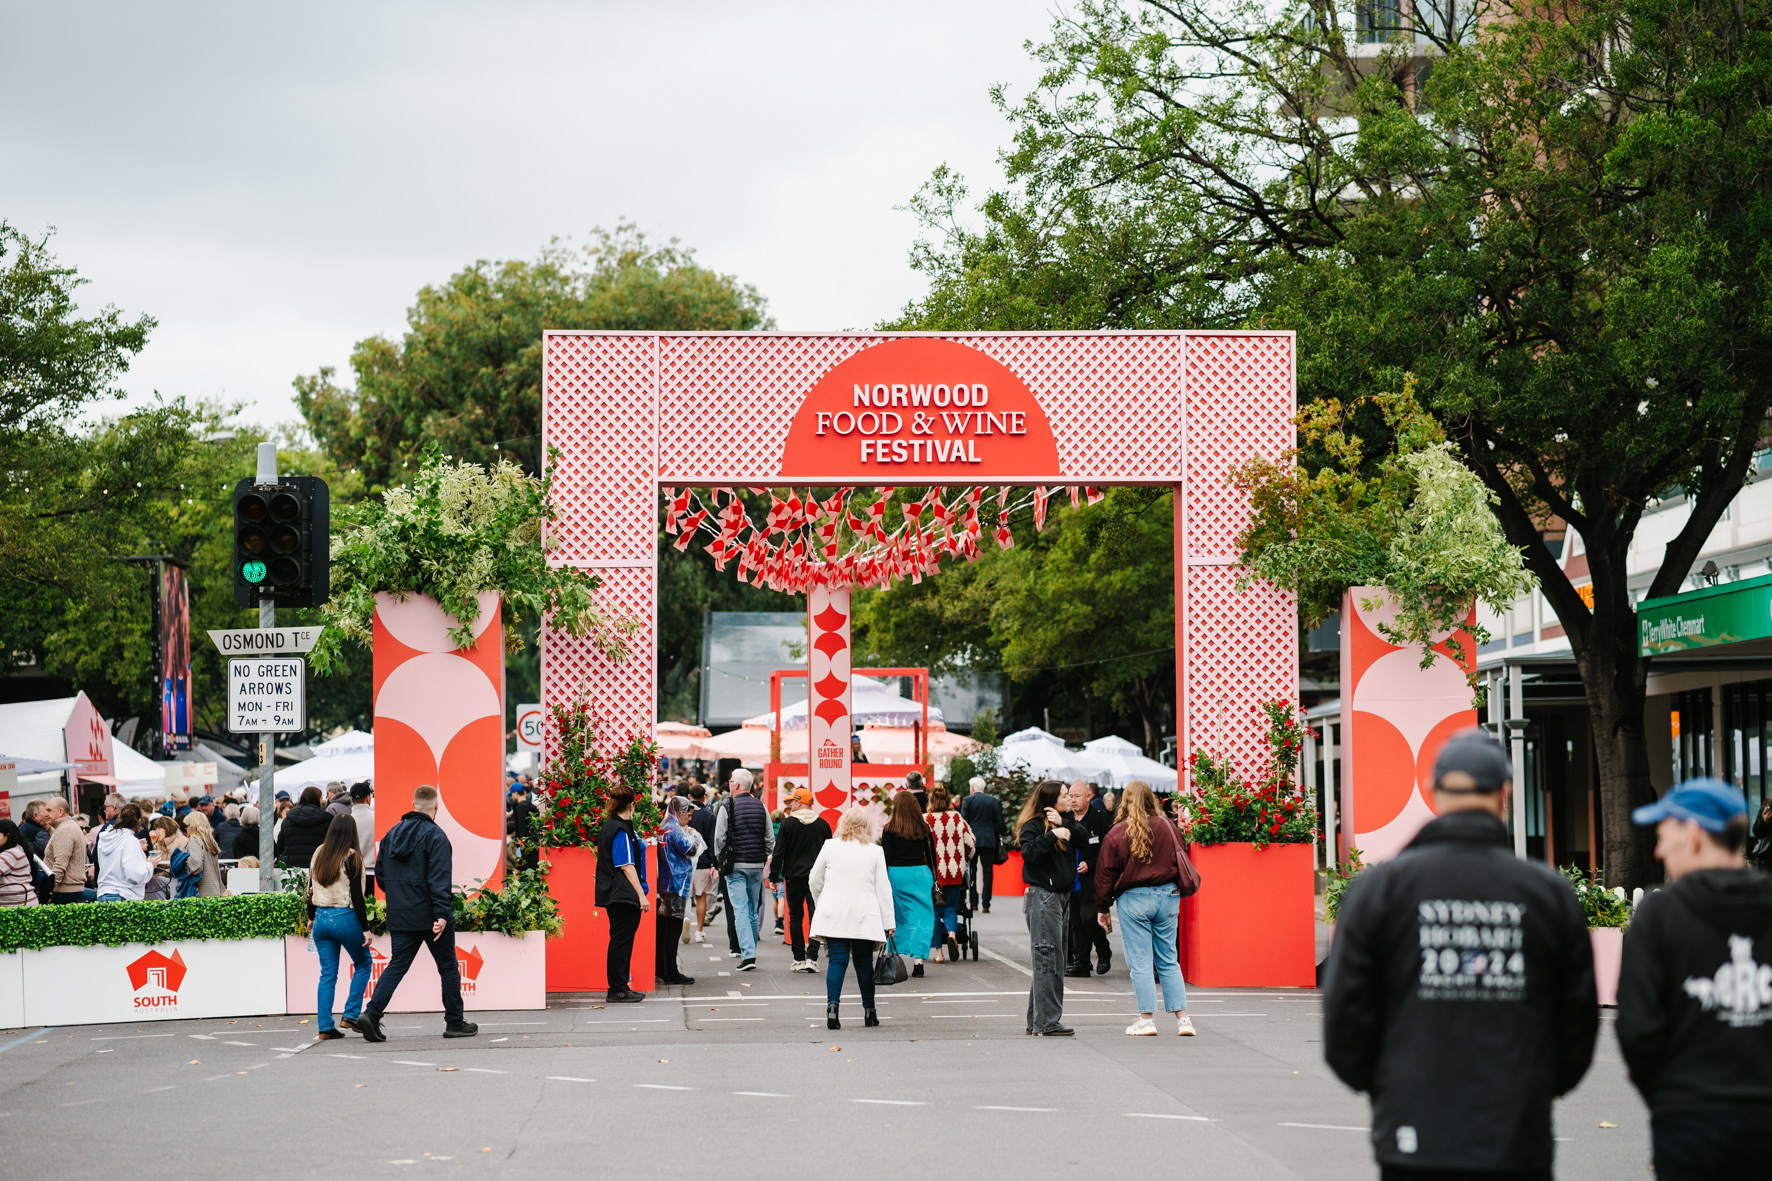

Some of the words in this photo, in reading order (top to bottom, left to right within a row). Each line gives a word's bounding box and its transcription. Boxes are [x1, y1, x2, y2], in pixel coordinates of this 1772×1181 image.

[853, 383, 989, 407] NORWOOD
[815, 411, 903, 435] FOOD
[911, 411, 934, 435] &
[940, 411, 1027, 436] WINE
[861, 439, 982, 463] FESTIVAL
[1648, 619, 1676, 648] TerryWhite
[1676, 614, 1705, 638] Chemmart
[222, 632, 285, 650] OSMOND
[234, 665, 250, 677] NO
[257, 664, 297, 678] GREEN
[239, 682, 292, 695] ARROWS
[237, 701, 263, 712] MON
[275, 701, 294, 712] FRI
[237, 715, 258, 726] 7AM
[273, 714, 294, 726] 9AM
[818, 748, 843, 758] GATHER
[819, 759, 842, 768] ROUND
[133, 995, 178, 1008] SOUTH
